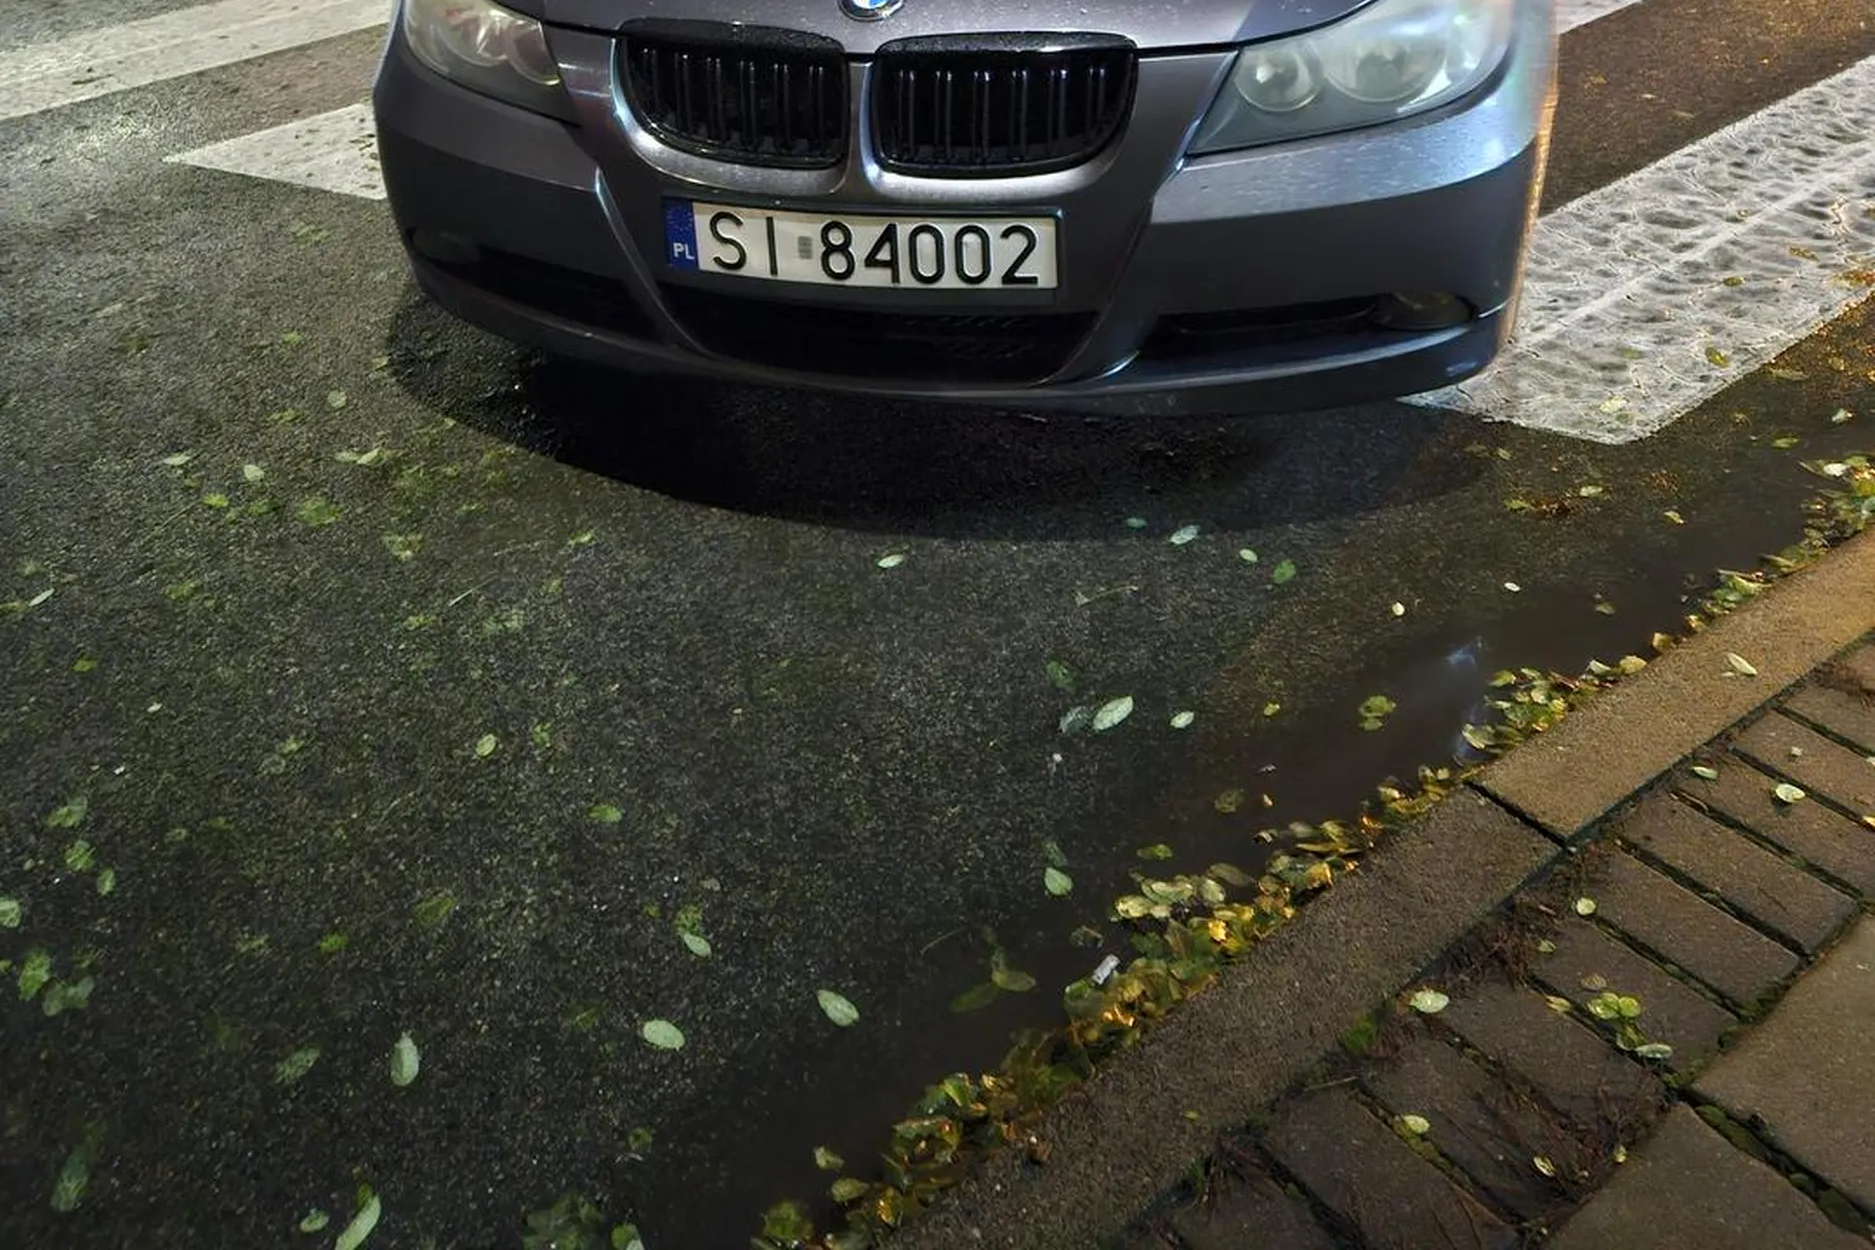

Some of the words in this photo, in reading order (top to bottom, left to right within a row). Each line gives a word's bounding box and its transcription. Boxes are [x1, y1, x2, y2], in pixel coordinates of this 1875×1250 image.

[672, 242, 695, 260] PL
[709, 211, 779, 276] SI
[820, 220, 1039, 285] 84002
